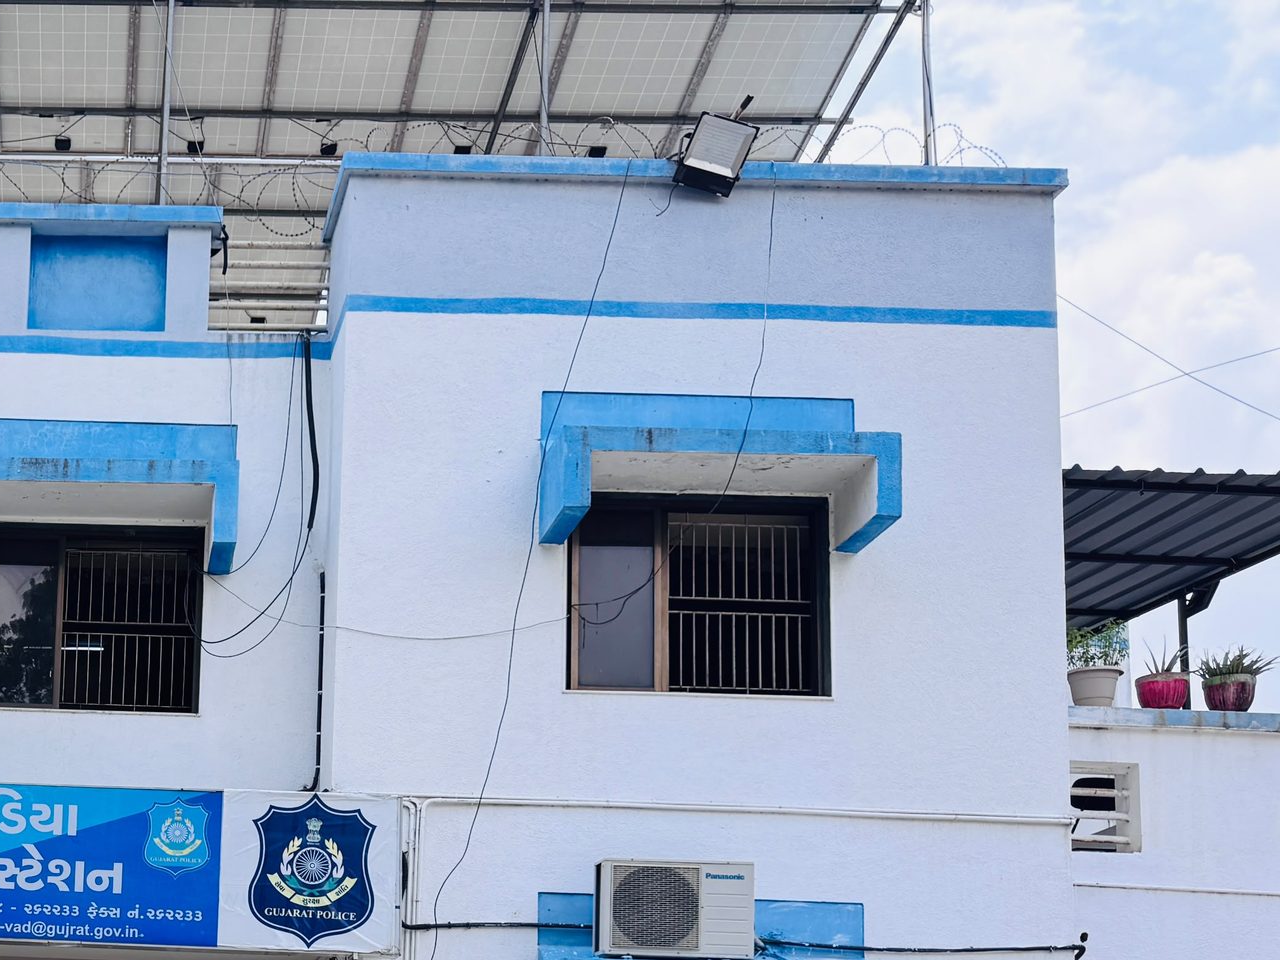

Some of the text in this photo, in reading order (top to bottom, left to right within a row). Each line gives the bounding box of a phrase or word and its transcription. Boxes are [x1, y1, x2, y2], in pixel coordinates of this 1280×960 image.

[705, 872, 745, 881] Panasonic
[23, 902, 80, 917] ૨૬૨૨૩૩
[86, 902, 120, 920] ફેક્સ
[264, 907, 357, 921] GUJARAT POLICE
